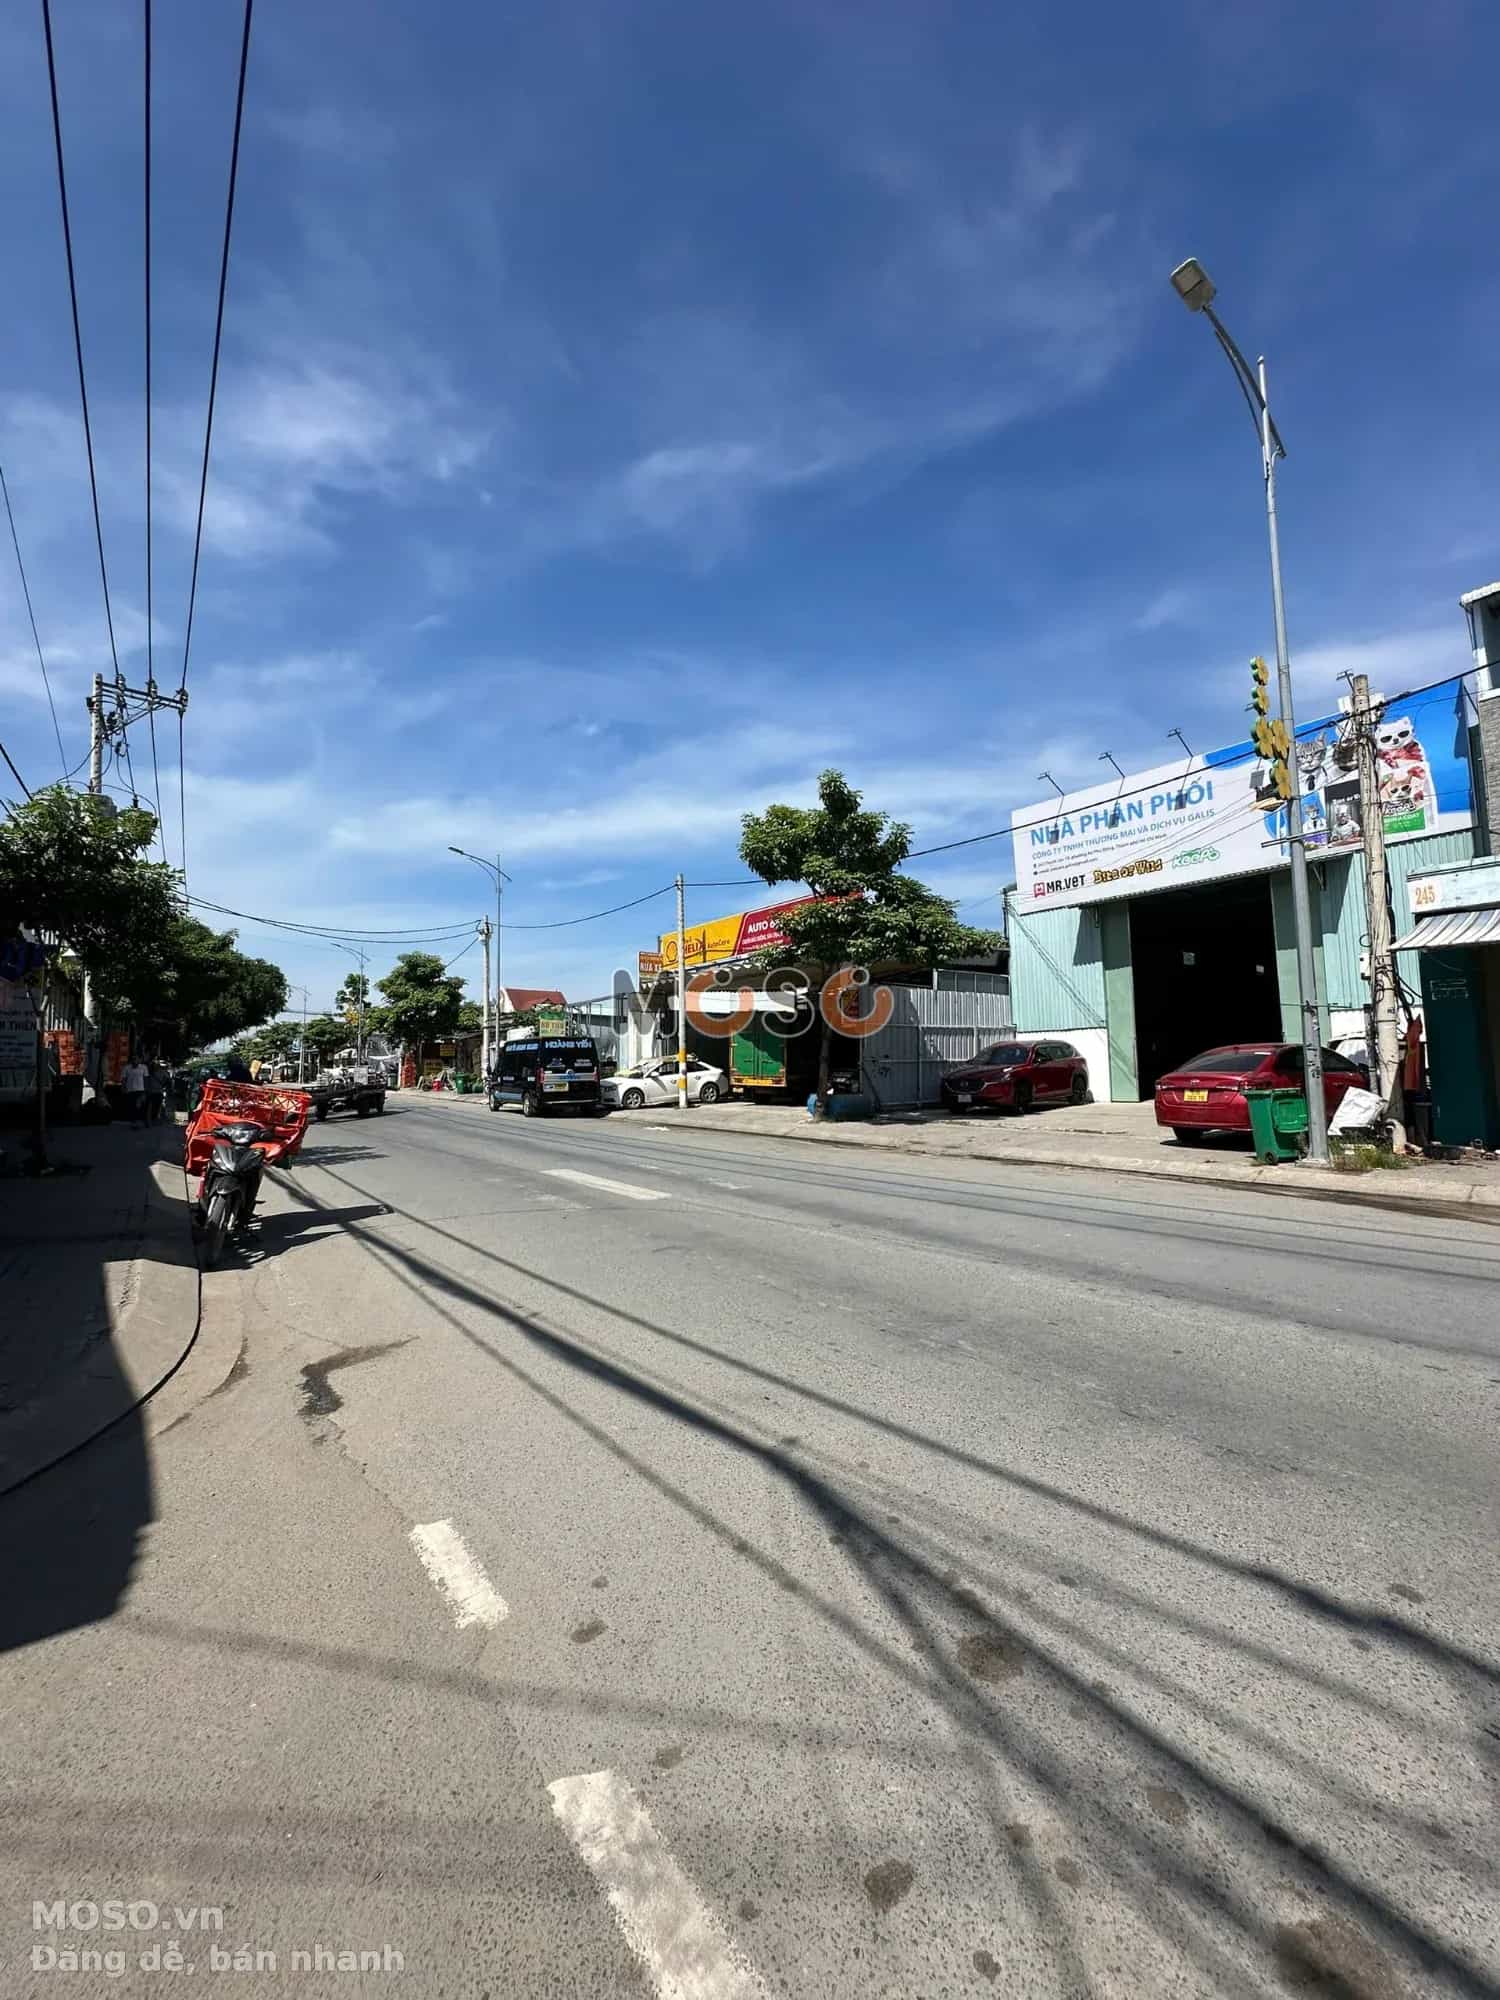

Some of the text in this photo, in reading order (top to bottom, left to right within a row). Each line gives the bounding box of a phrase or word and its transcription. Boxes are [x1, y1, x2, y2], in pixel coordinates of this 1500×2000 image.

[1030, 815, 1075, 846] NHÀ
[1080, 799, 1144, 834] PHÂN
[1151, 776, 1213, 816] PHỐI
[1063, 842, 1083, 853] TNHH
[1416, 885, 1435, 905] 245
[748, 921, 768, 934] AUTO
